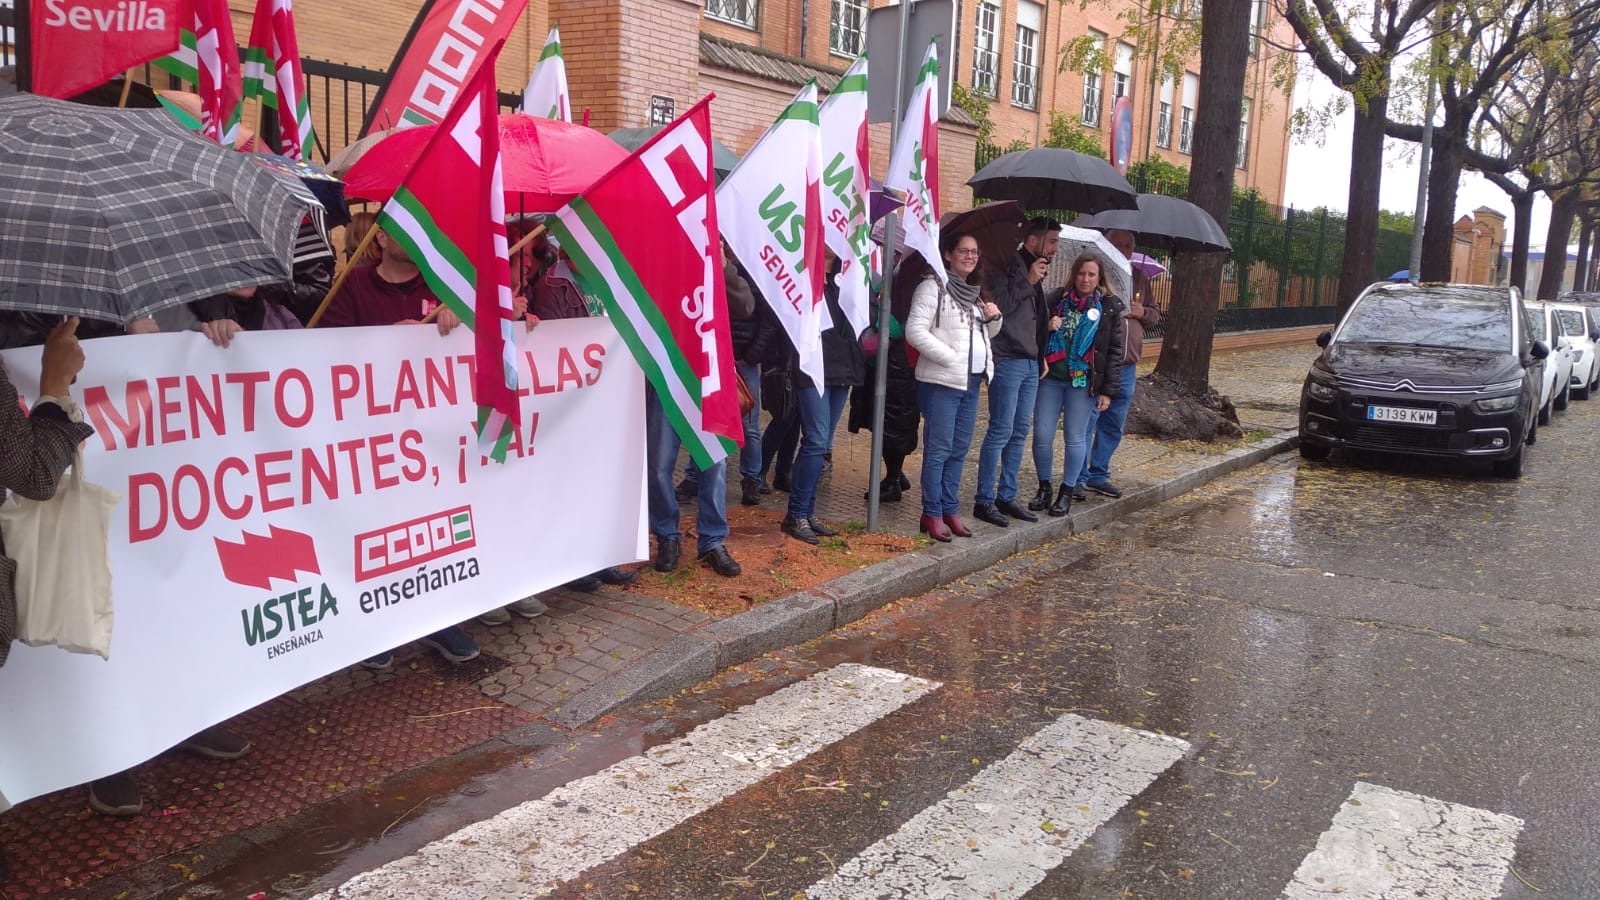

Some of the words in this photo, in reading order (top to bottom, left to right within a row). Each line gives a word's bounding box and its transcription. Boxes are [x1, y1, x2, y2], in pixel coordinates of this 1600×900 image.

[45, 0, 166, 32] Sevilla
[759, 244, 803, 316] SEVILL
[331, 343, 606, 421] PLANTLAS
[1376, 408, 1407, 421] 3139
[1410, 410, 1434, 423] KWM
[128, 428, 440, 544] DOCENTES,
[361, 515, 453, 573] CCOO
[359, 556, 480, 614] enseñanza
[241, 582, 339, 647] USTEA
[266, 628, 324, 660] ENSEÑANZA
